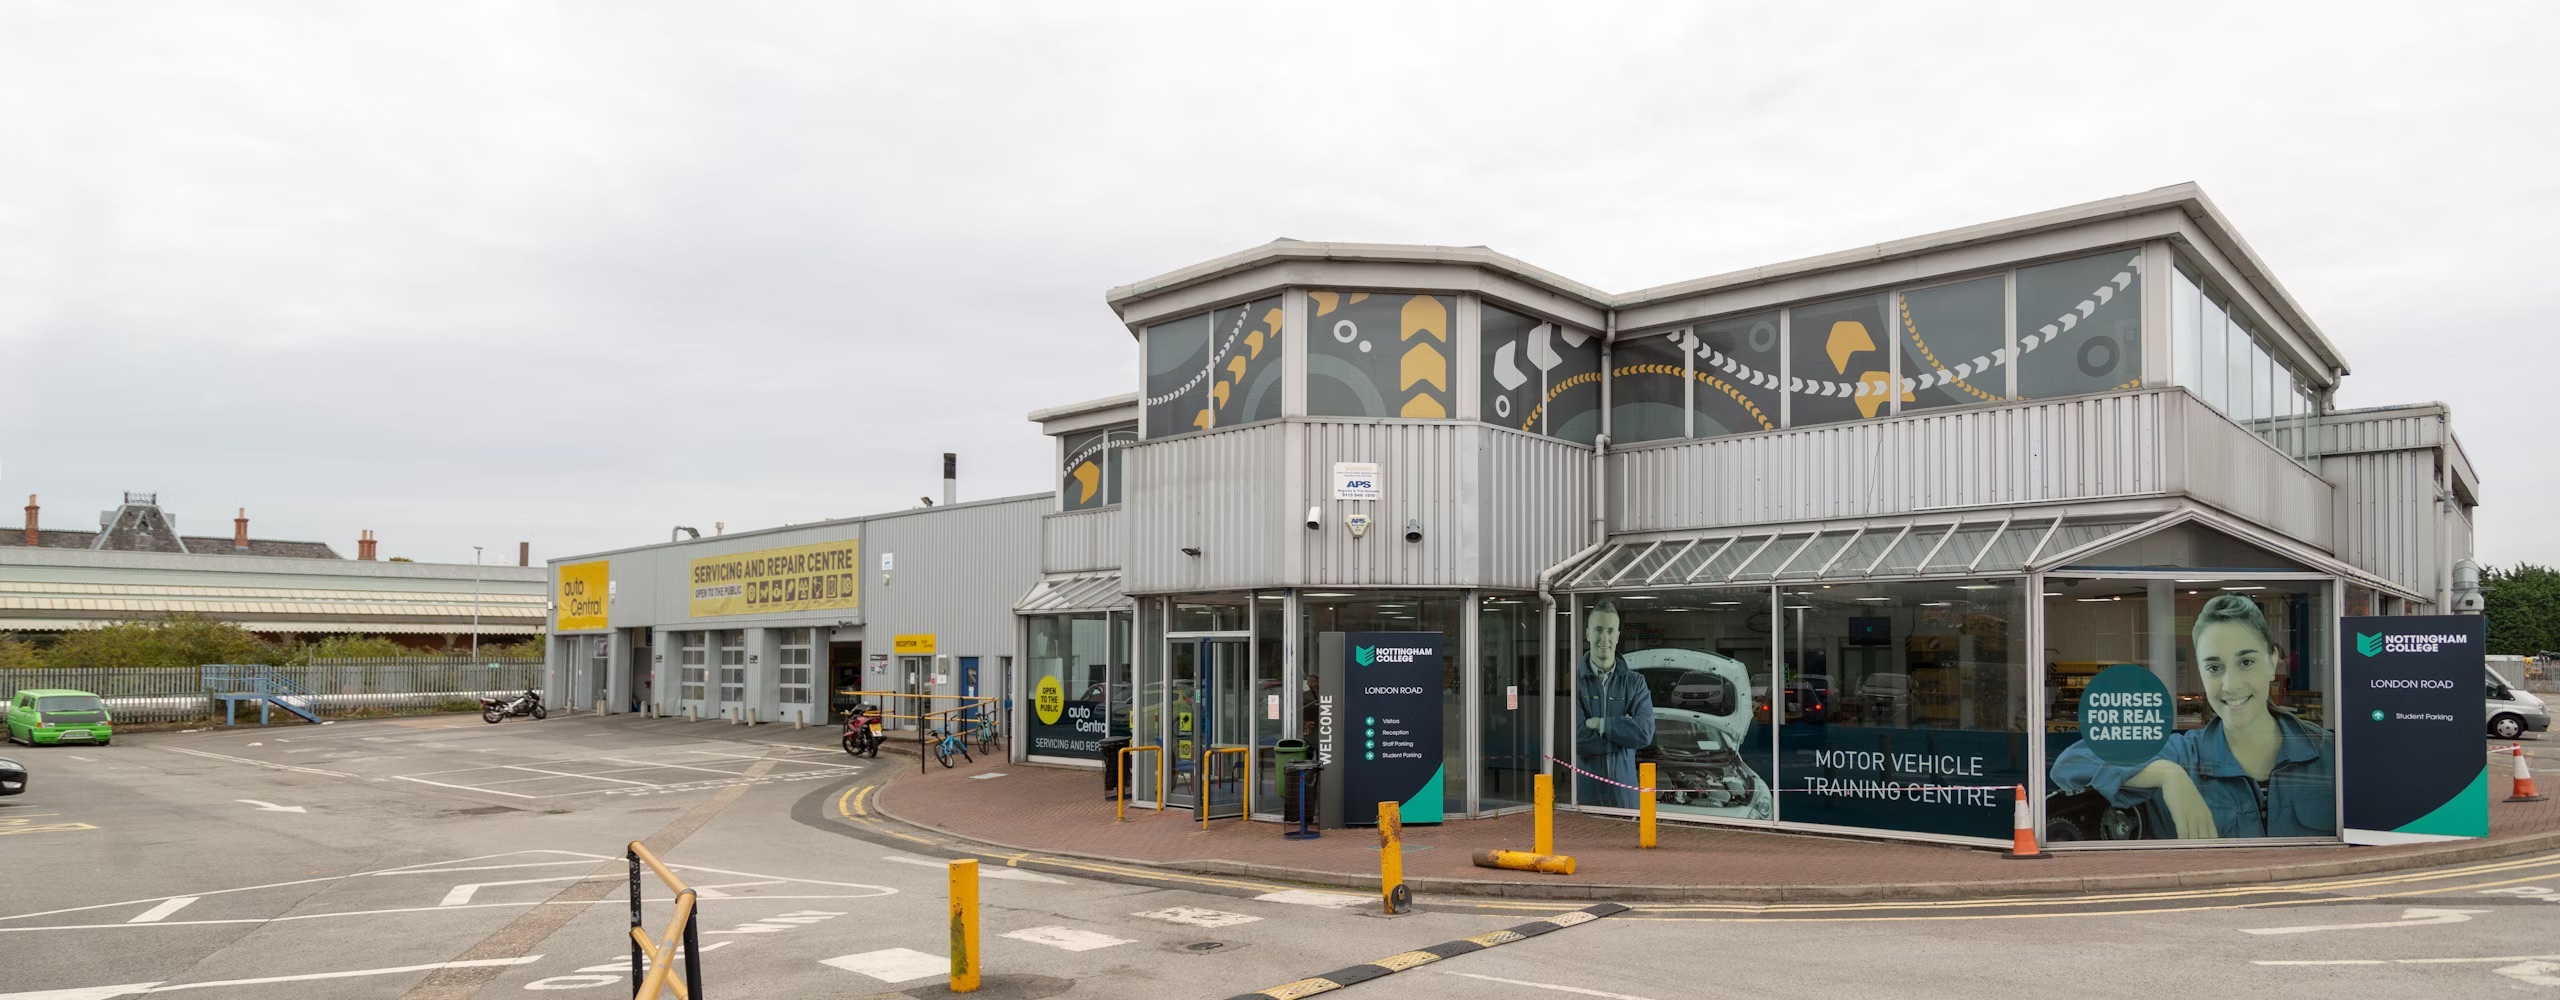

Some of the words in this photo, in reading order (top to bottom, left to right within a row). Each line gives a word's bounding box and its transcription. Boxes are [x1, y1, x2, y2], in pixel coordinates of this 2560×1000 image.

[694, 562, 742, 584] SERVICING
[744, 559, 764, 578] AND
[767, 554, 804, 576] REPAIR
[808, 549, 852, 572] CENTRE
[564, 577, 584, 596] auto
[695, 588, 707, 598] OPEN
[708, 587, 714, 596] TO
[714, 586, 724, 596] THE
[724, 586, 742, 596] PUBLIC
[570, 596, 602, 616] Central
[2385, 634, 2467, 643] NOTTINGHAM
[2385, 644, 2438, 652] COLLEGE
[2370, 680, 2418, 688] LONDON
[2421, 680, 2454, 689] ROAD
[2089, 692, 2163, 707] COURSES
[1068, 705, 1090, 718] auto
[2088, 709, 2119, 724] FOR
[2123, 710, 2165, 724] REAL
[2426, 713, 2453, 721] Parking
[1076, 719, 1106, 733] Centra
[1320, 695, 1332, 765] WELCOME
[2090, 726, 2163, 740] CAREERS
[1036, 738, 1069, 749] SERVICING
[1070, 740, 1084, 750] AND
[1086, 741, 1101, 752] REP
[1815, 750, 1885, 771] MOTOR
[1891, 753, 1983, 776] VEHICLE
[1804, 777, 1900, 800] TRAINING
[1908, 783, 1996, 807] CENTRE
